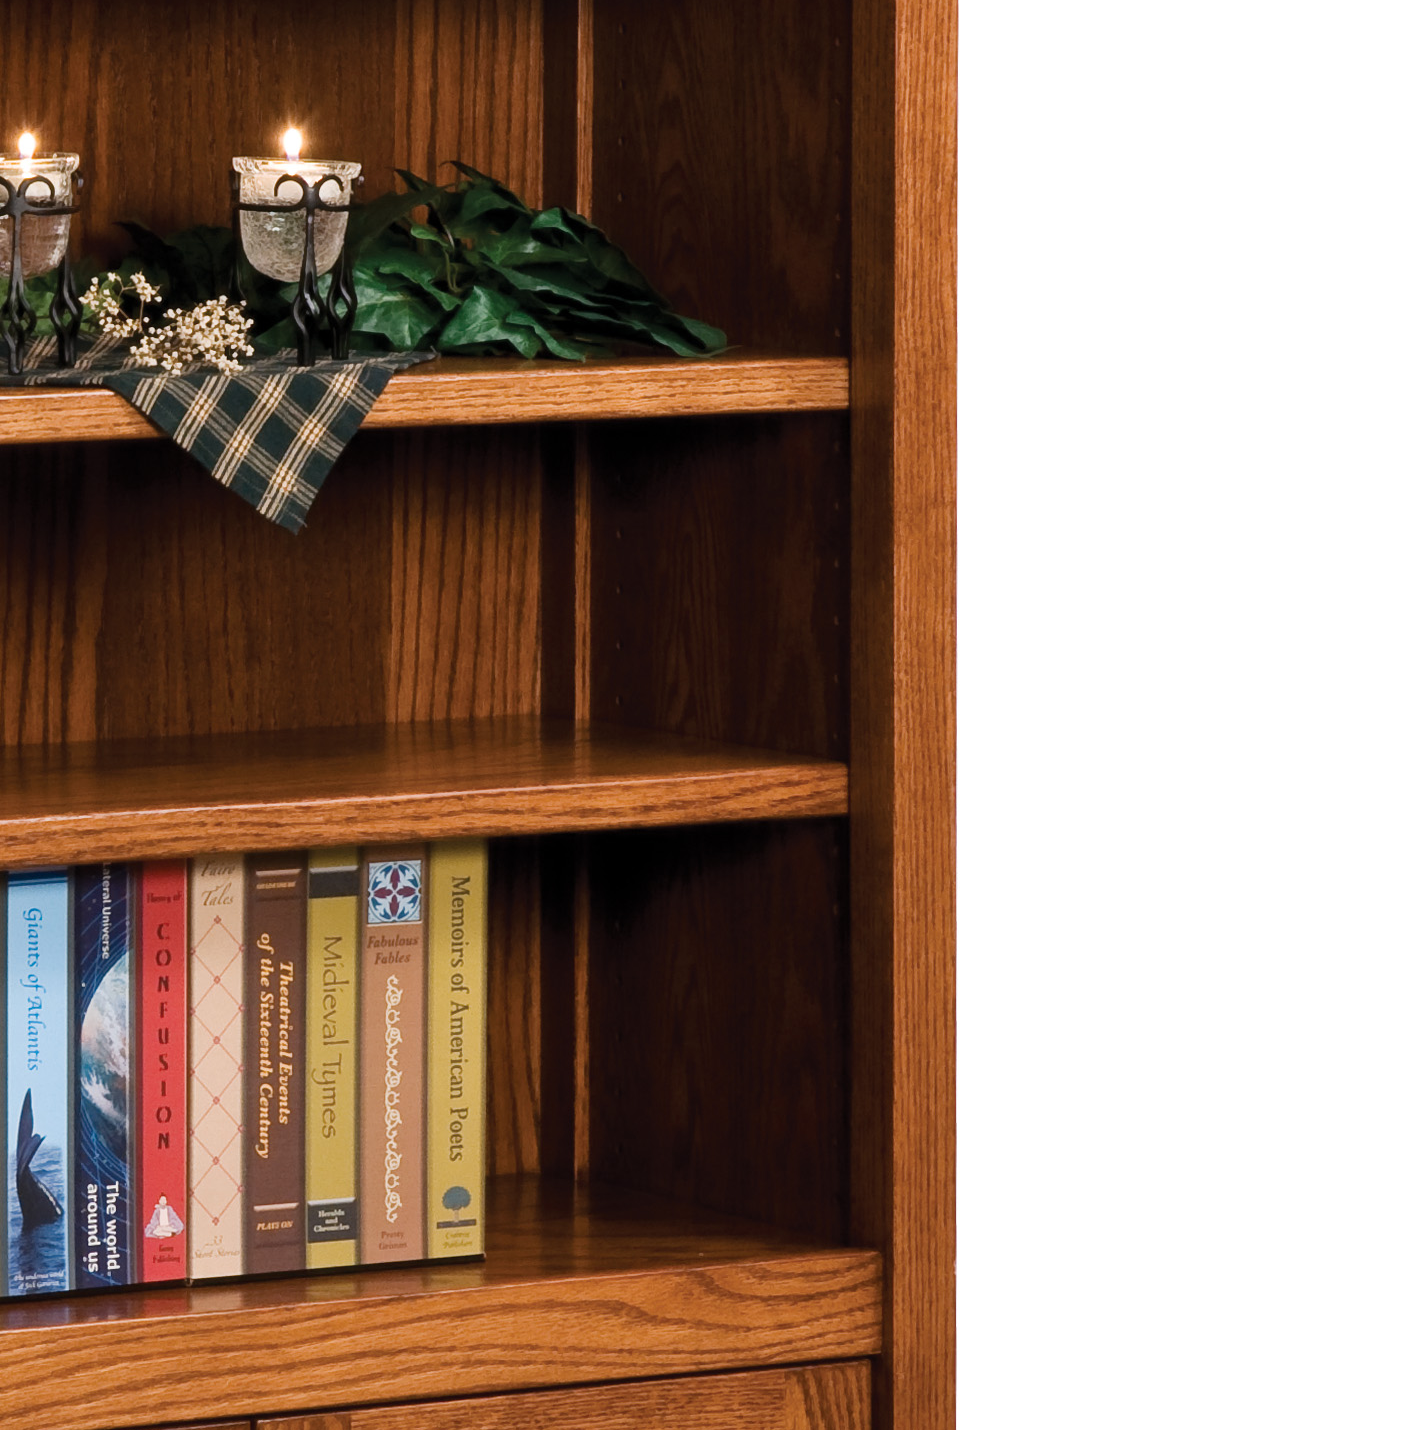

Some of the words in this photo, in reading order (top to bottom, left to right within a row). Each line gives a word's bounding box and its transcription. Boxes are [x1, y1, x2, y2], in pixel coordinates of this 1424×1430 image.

[201, 882, 234, 907] Tales
[450, 876, 471, 969] Memoirs
[22, 907, 43, 969] Giants
[102, 905, 112, 960] Universe
[256, 932, 275, 956] of
[366, 934, 419, 949] Fabulous
[374, 951, 412, 965] Fables
[19, 973, 47, 994] of
[260, 958, 275, 988] the
[322, 936, 350, 1046] Midieval
[450, 973, 470, 995] of
[26, 996, 47, 1072] Atlantis
[155, 922, 172, 1150] CONFUSION
[259, 990, 274, 1078] Sixteenth
[279, 960, 294, 1059] Theatrical
[449, 1001, 470, 1100] American
[255, 1083, 274, 1159] Century
[278, 1062, 293, 1125] Events
[311, 1052, 342, 1139] Tymes
[449, 1107, 469, 1162] Poets
[86, 1183, 101, 1247] around
[106, 1180, 120, 1215] The
[256, 1221, 279, 1231] PLAYS
[280, 1220, 294, 1229] ON
[87, 1252, 99, 1273] us
